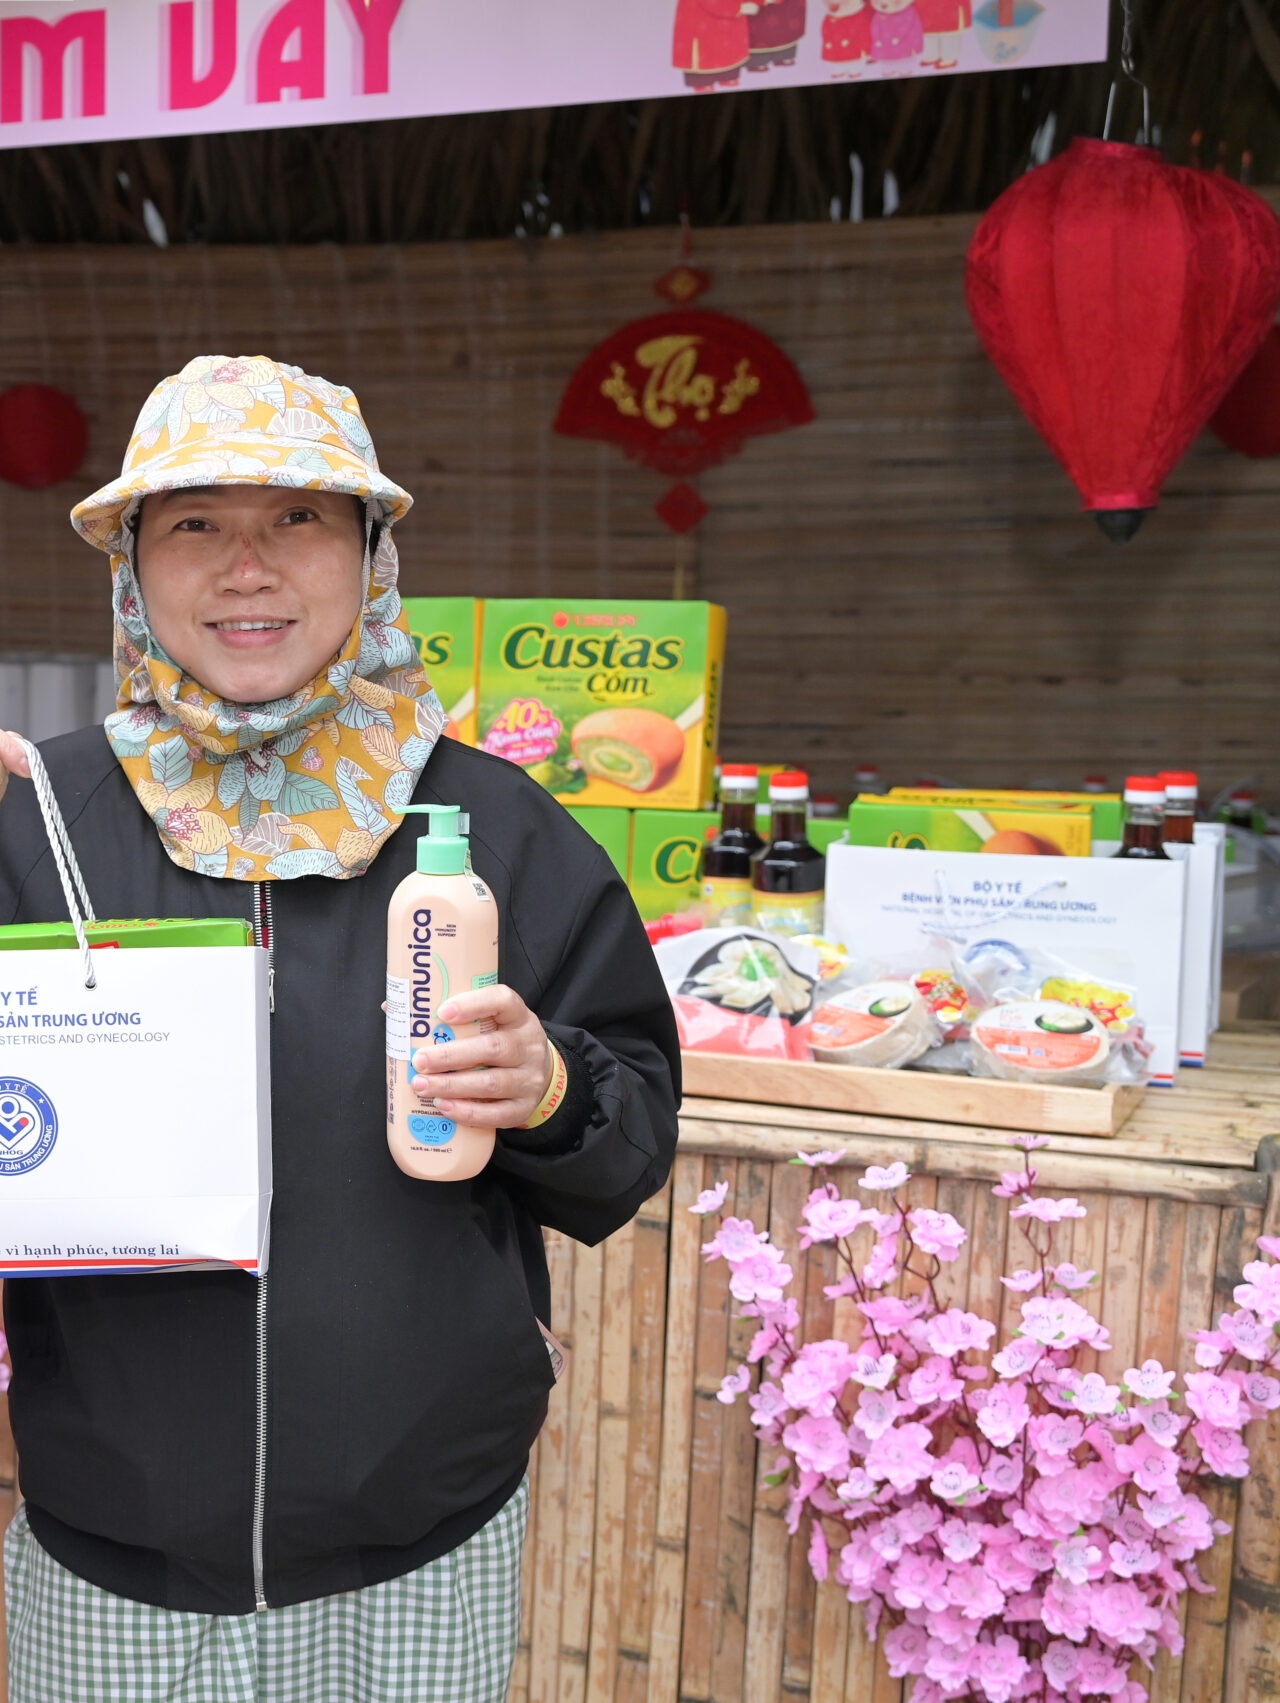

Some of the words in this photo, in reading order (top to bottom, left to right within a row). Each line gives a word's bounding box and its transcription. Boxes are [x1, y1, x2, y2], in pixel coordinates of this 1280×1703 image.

[504, 625, 682, 671] Custas
[996, 882, 1004, 893] Y
[1019, 898, 1058, 911] RUNG
[407, 908, 431, 1038] bimunica
[0, 991, 12, 1006] Y
[15, 986, 38, 1006] TẾ
[31, 1013, 88, 1028] TRUNG
[92, 1011, 142, 1026] ƯƠNG
[58, 1033, 84, 1044] AND
[86, 1032, 170, 1044] GYNECOLOGY
[4, 1082, 11, 1091] Y
[22, 1146, 46, 1167] TRUNG
[6, 1244, 19, 1256] vì
[24, 1244, 61, 1259] hạnh
[66, 1244, 109, 1257] phúc,
[112, 1245, 157, 1257] tương
[161, 1244, 180, 1256] lai
